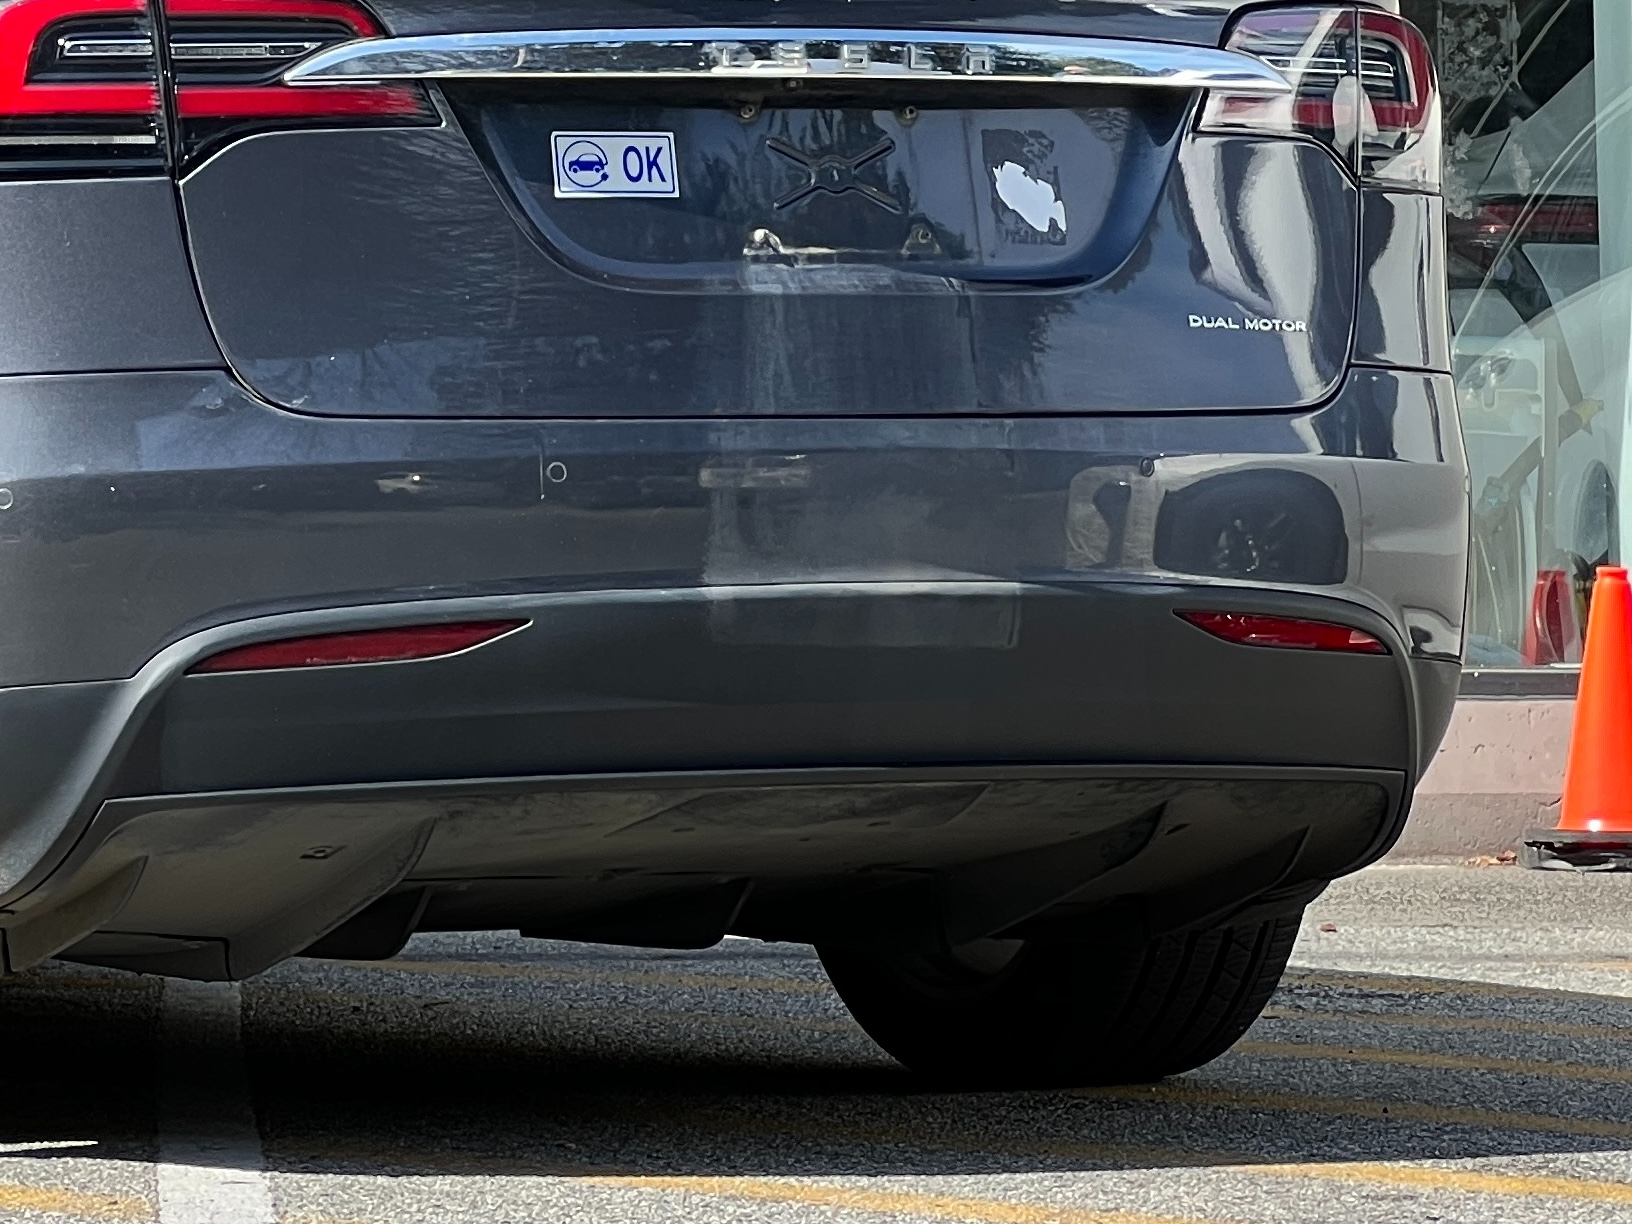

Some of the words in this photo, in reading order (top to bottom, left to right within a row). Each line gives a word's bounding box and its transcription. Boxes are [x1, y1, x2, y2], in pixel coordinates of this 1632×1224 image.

[623, 146, 666, 182] OK
[1188, 314, 1240, 329] DUAL
[1245, 317, 1307, 332] MOTOR
